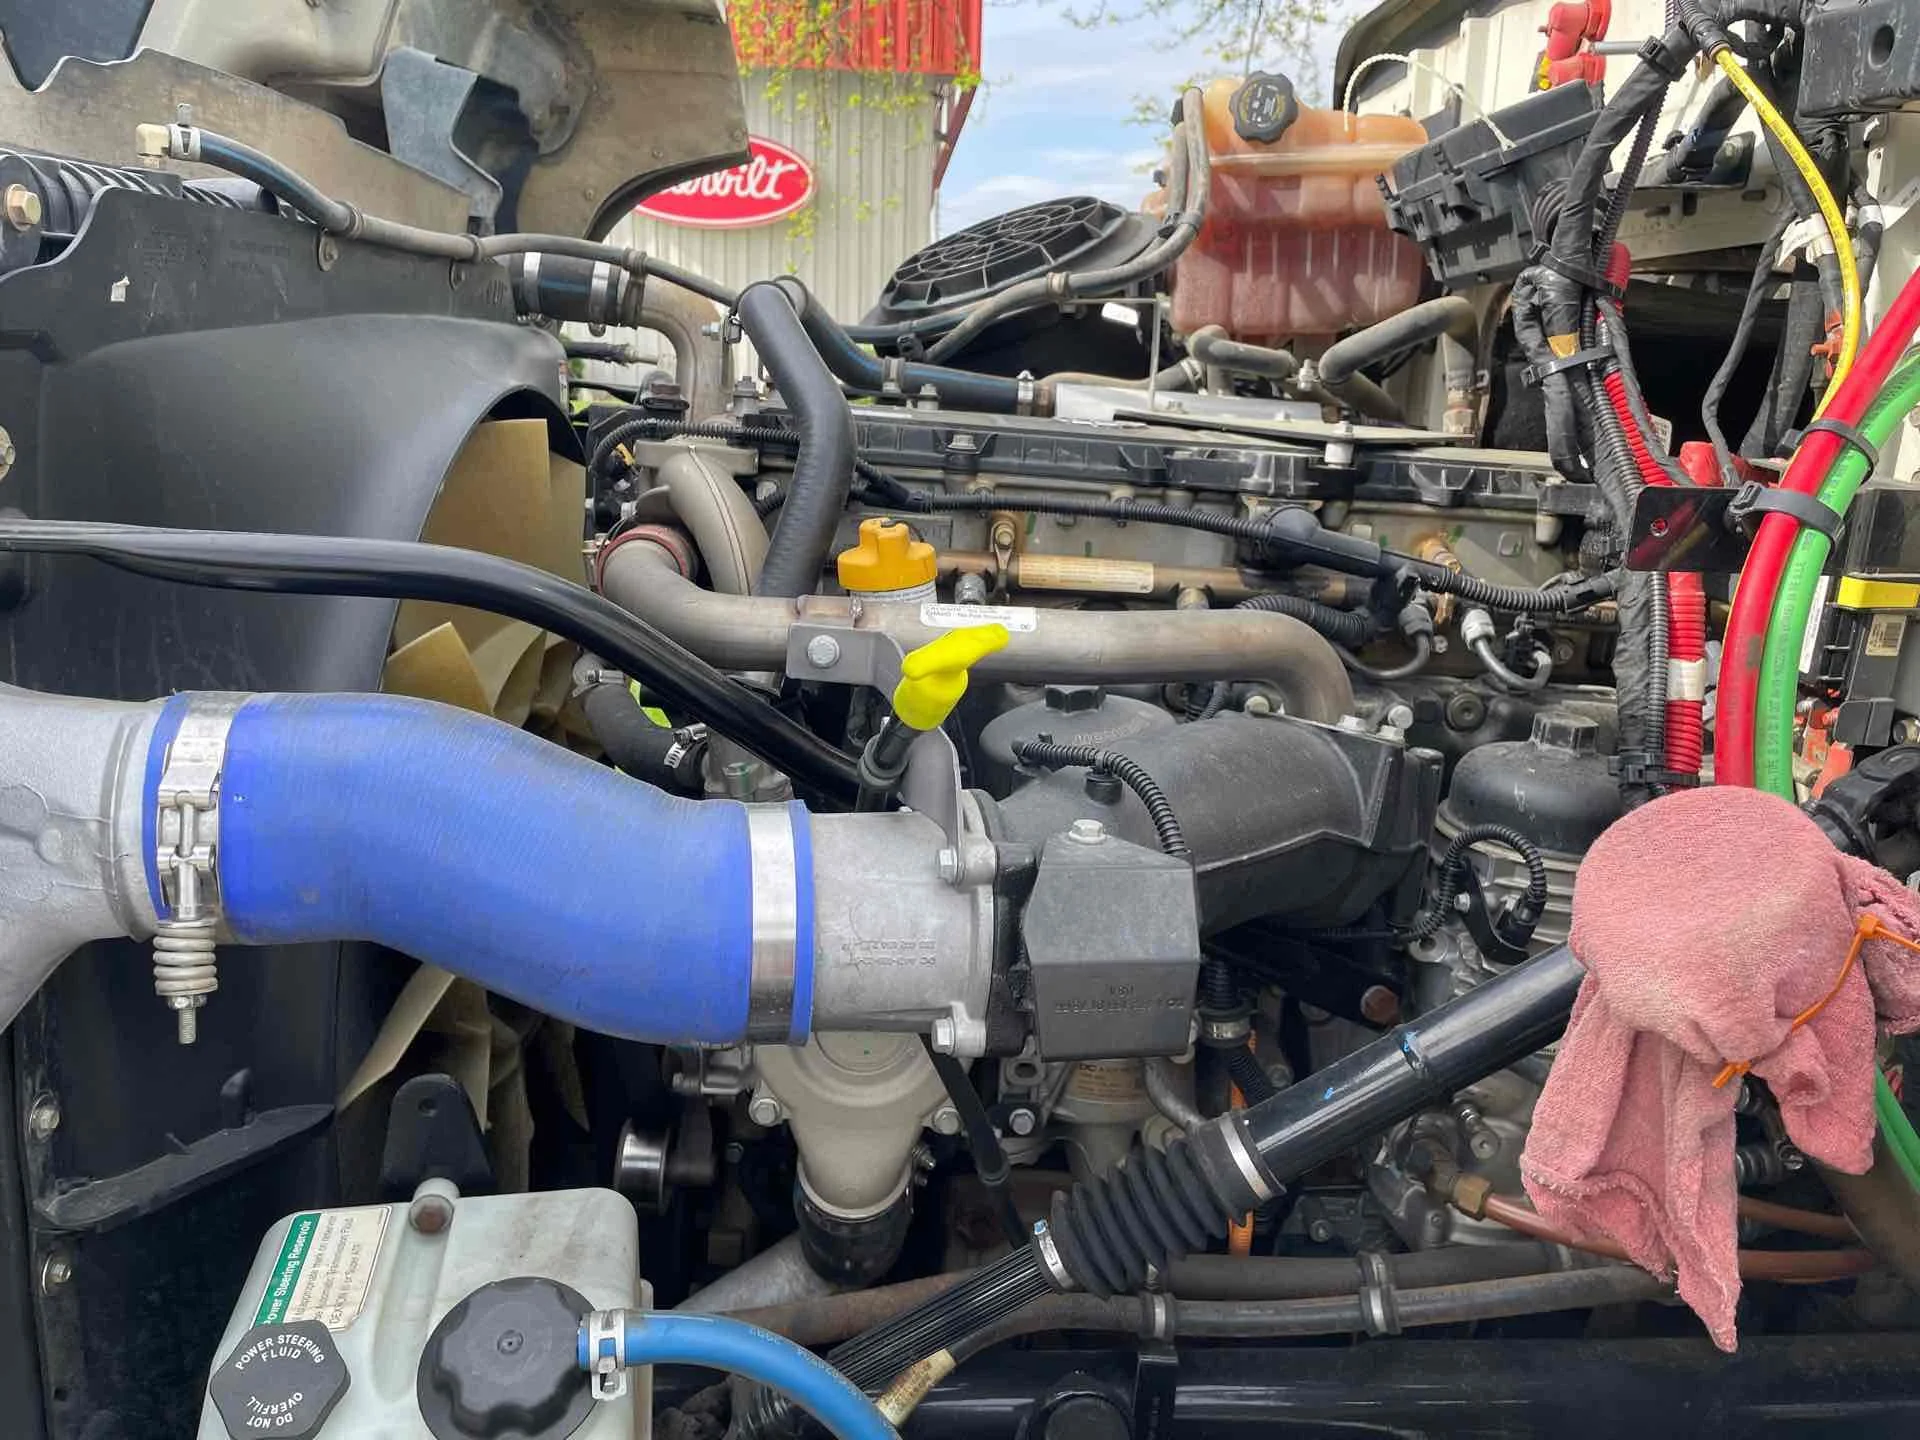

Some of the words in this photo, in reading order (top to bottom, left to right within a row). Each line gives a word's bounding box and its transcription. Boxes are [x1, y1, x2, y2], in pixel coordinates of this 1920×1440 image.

[274, 1260, 301, 1297] Steering
[289, 1220, 313, 1259] Reservoir
[235, 1337, 274, 1370] POWER
[278, 1334, 325, 1364] STEERING
[261, 1346, 301, 1362] FLUID
[246, 1392, 303, 1415] OVERFILL
[246, 1415, 272, 1429] NOT
[275, 1412, 293, 1426] DO
